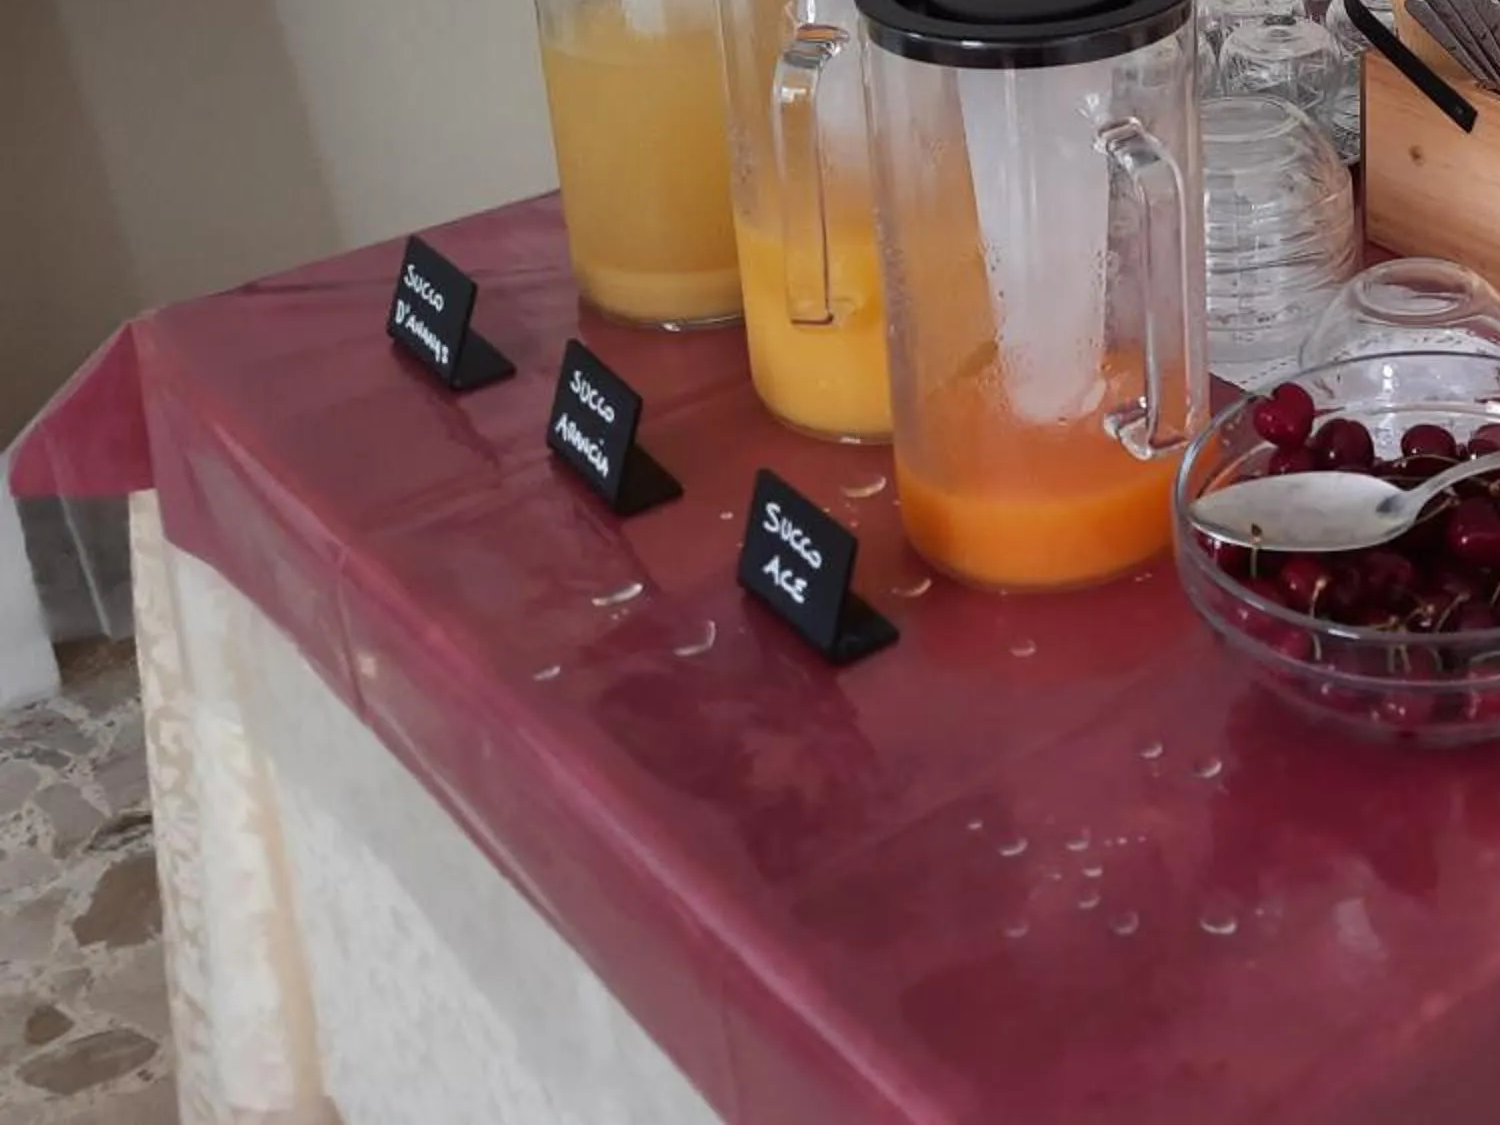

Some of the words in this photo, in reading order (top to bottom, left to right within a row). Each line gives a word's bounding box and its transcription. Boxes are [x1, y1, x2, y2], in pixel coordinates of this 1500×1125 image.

[404, 264, 444, 312] SUCCO
[570, 370, 615, 423] SUCCO
[763, 502, 822, 569] SUCCO
[763, 555, 807, 604] ACE
